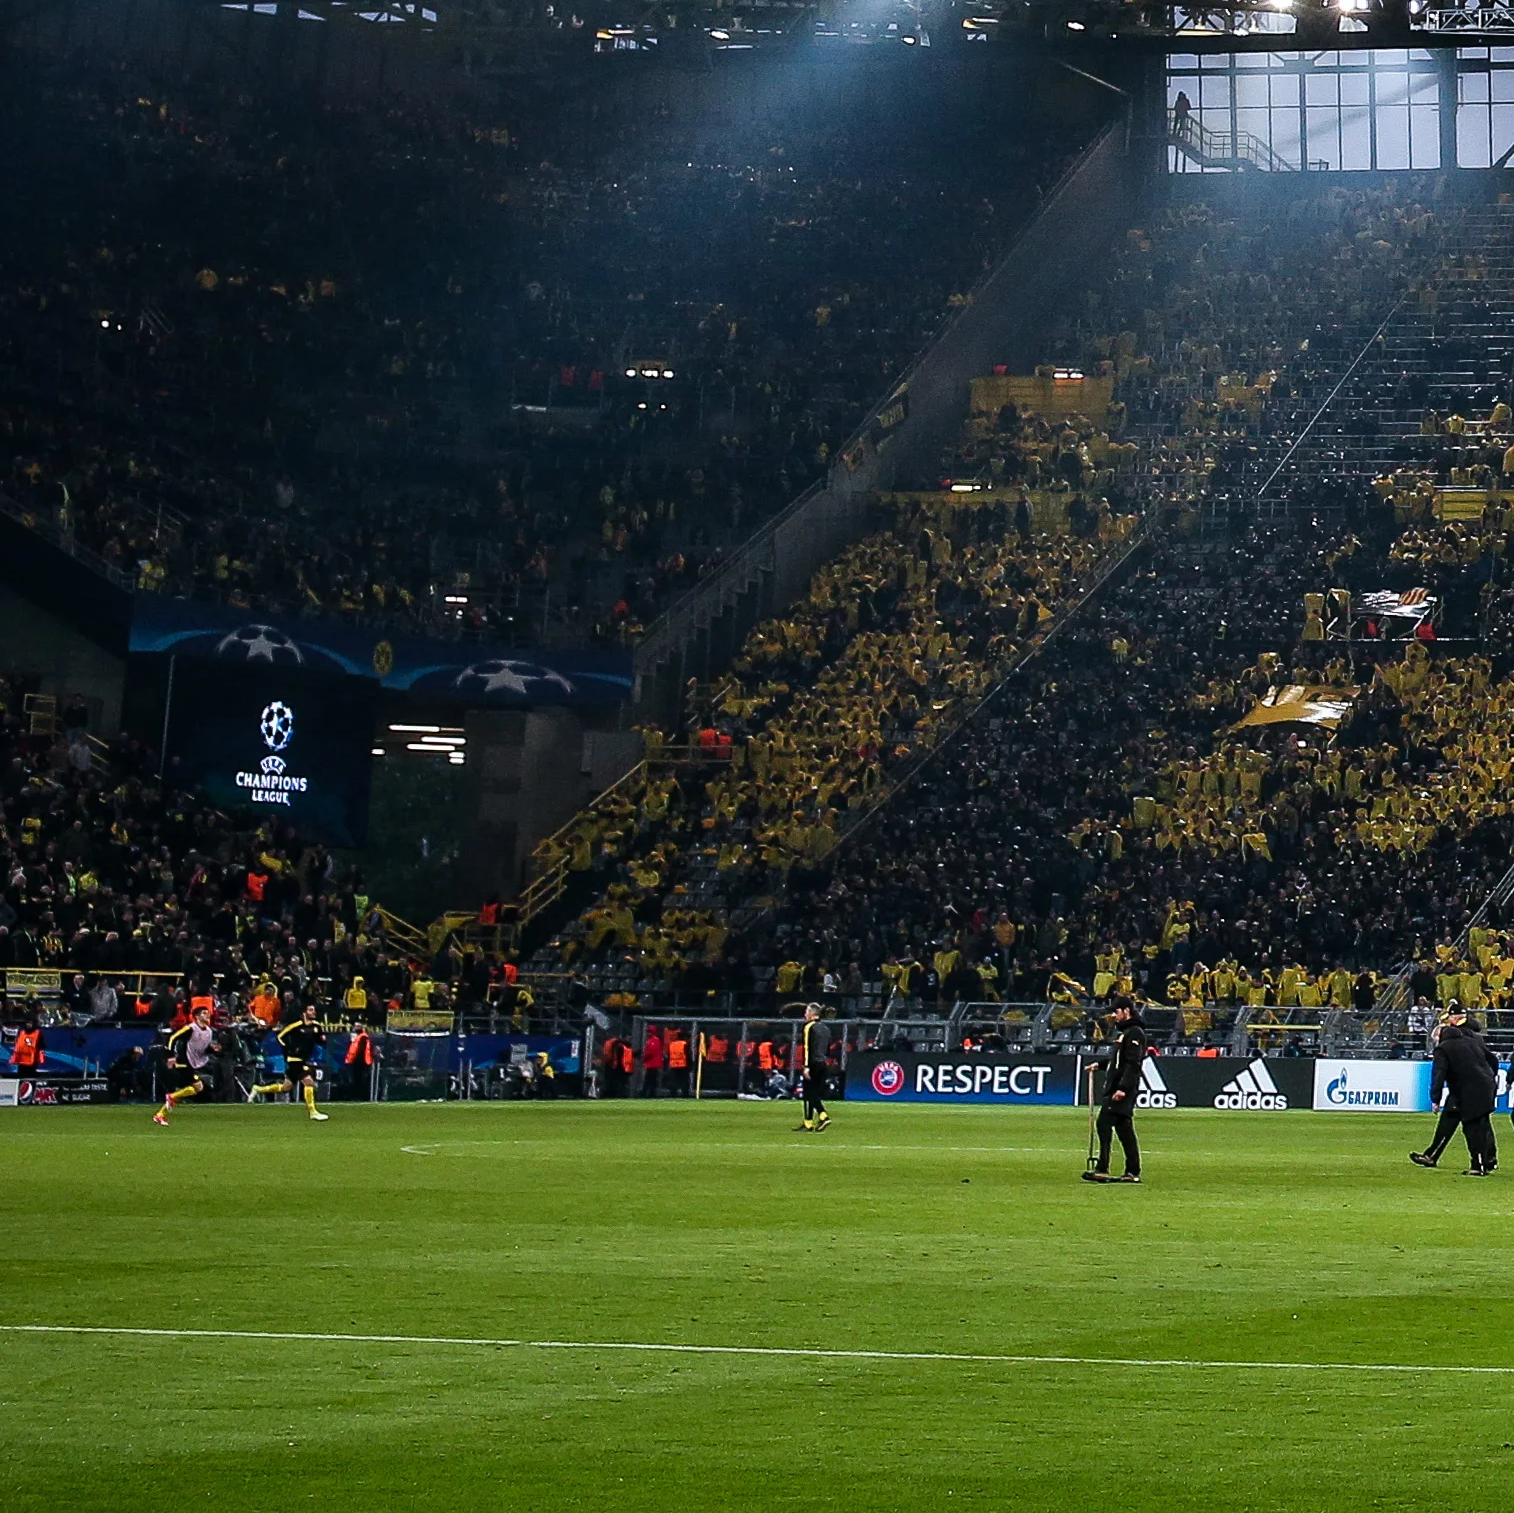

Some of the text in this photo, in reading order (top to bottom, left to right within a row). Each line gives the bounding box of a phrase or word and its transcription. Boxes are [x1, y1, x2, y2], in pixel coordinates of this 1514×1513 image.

[235, 771, 307, 792] CHAMPIONS
[251, 789, 291, 806] LEAGUE
[916, 1064, 1052, 1095] RESPECT
[1136, 1090, 1178, 1108] das
[1214, 1090, 1288, 1110] adidas
[1347, 1091, 1399, 1105] GAZPROM
